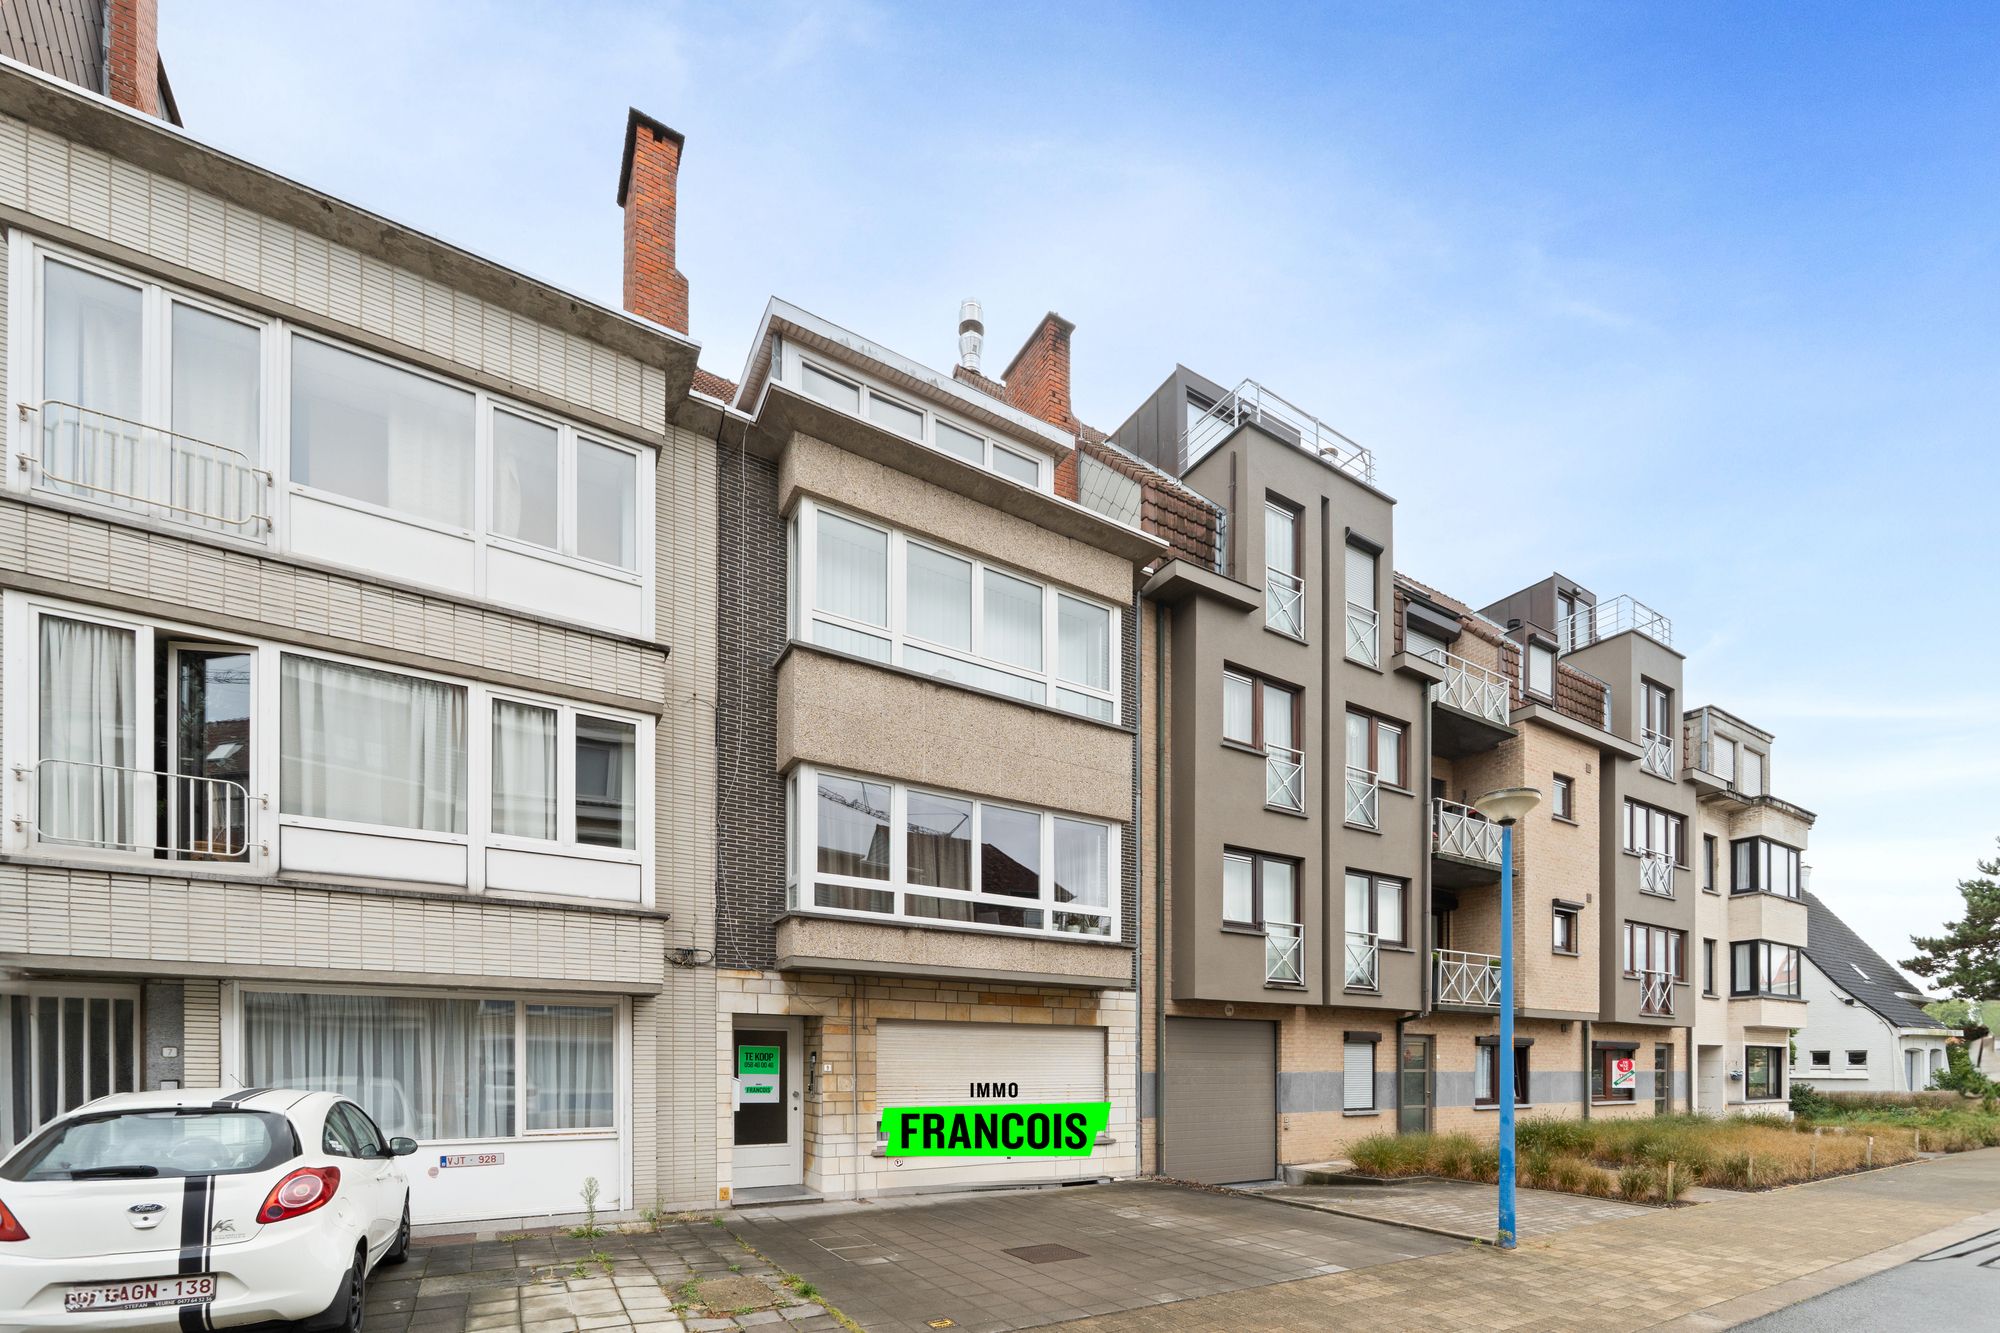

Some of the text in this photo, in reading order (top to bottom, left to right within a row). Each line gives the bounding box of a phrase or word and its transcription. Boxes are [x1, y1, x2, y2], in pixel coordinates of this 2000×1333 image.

[744, 1052, 774, 1061] TE KOOP
[447, 1156, 466, 1166] VJT
[478, 1154, 497, 1164] 928
[134, 1204, 158, 1213] Ford
[175, 1278, 212, 1296] 138
[124, 1302, 148, 1310] STEFAN
